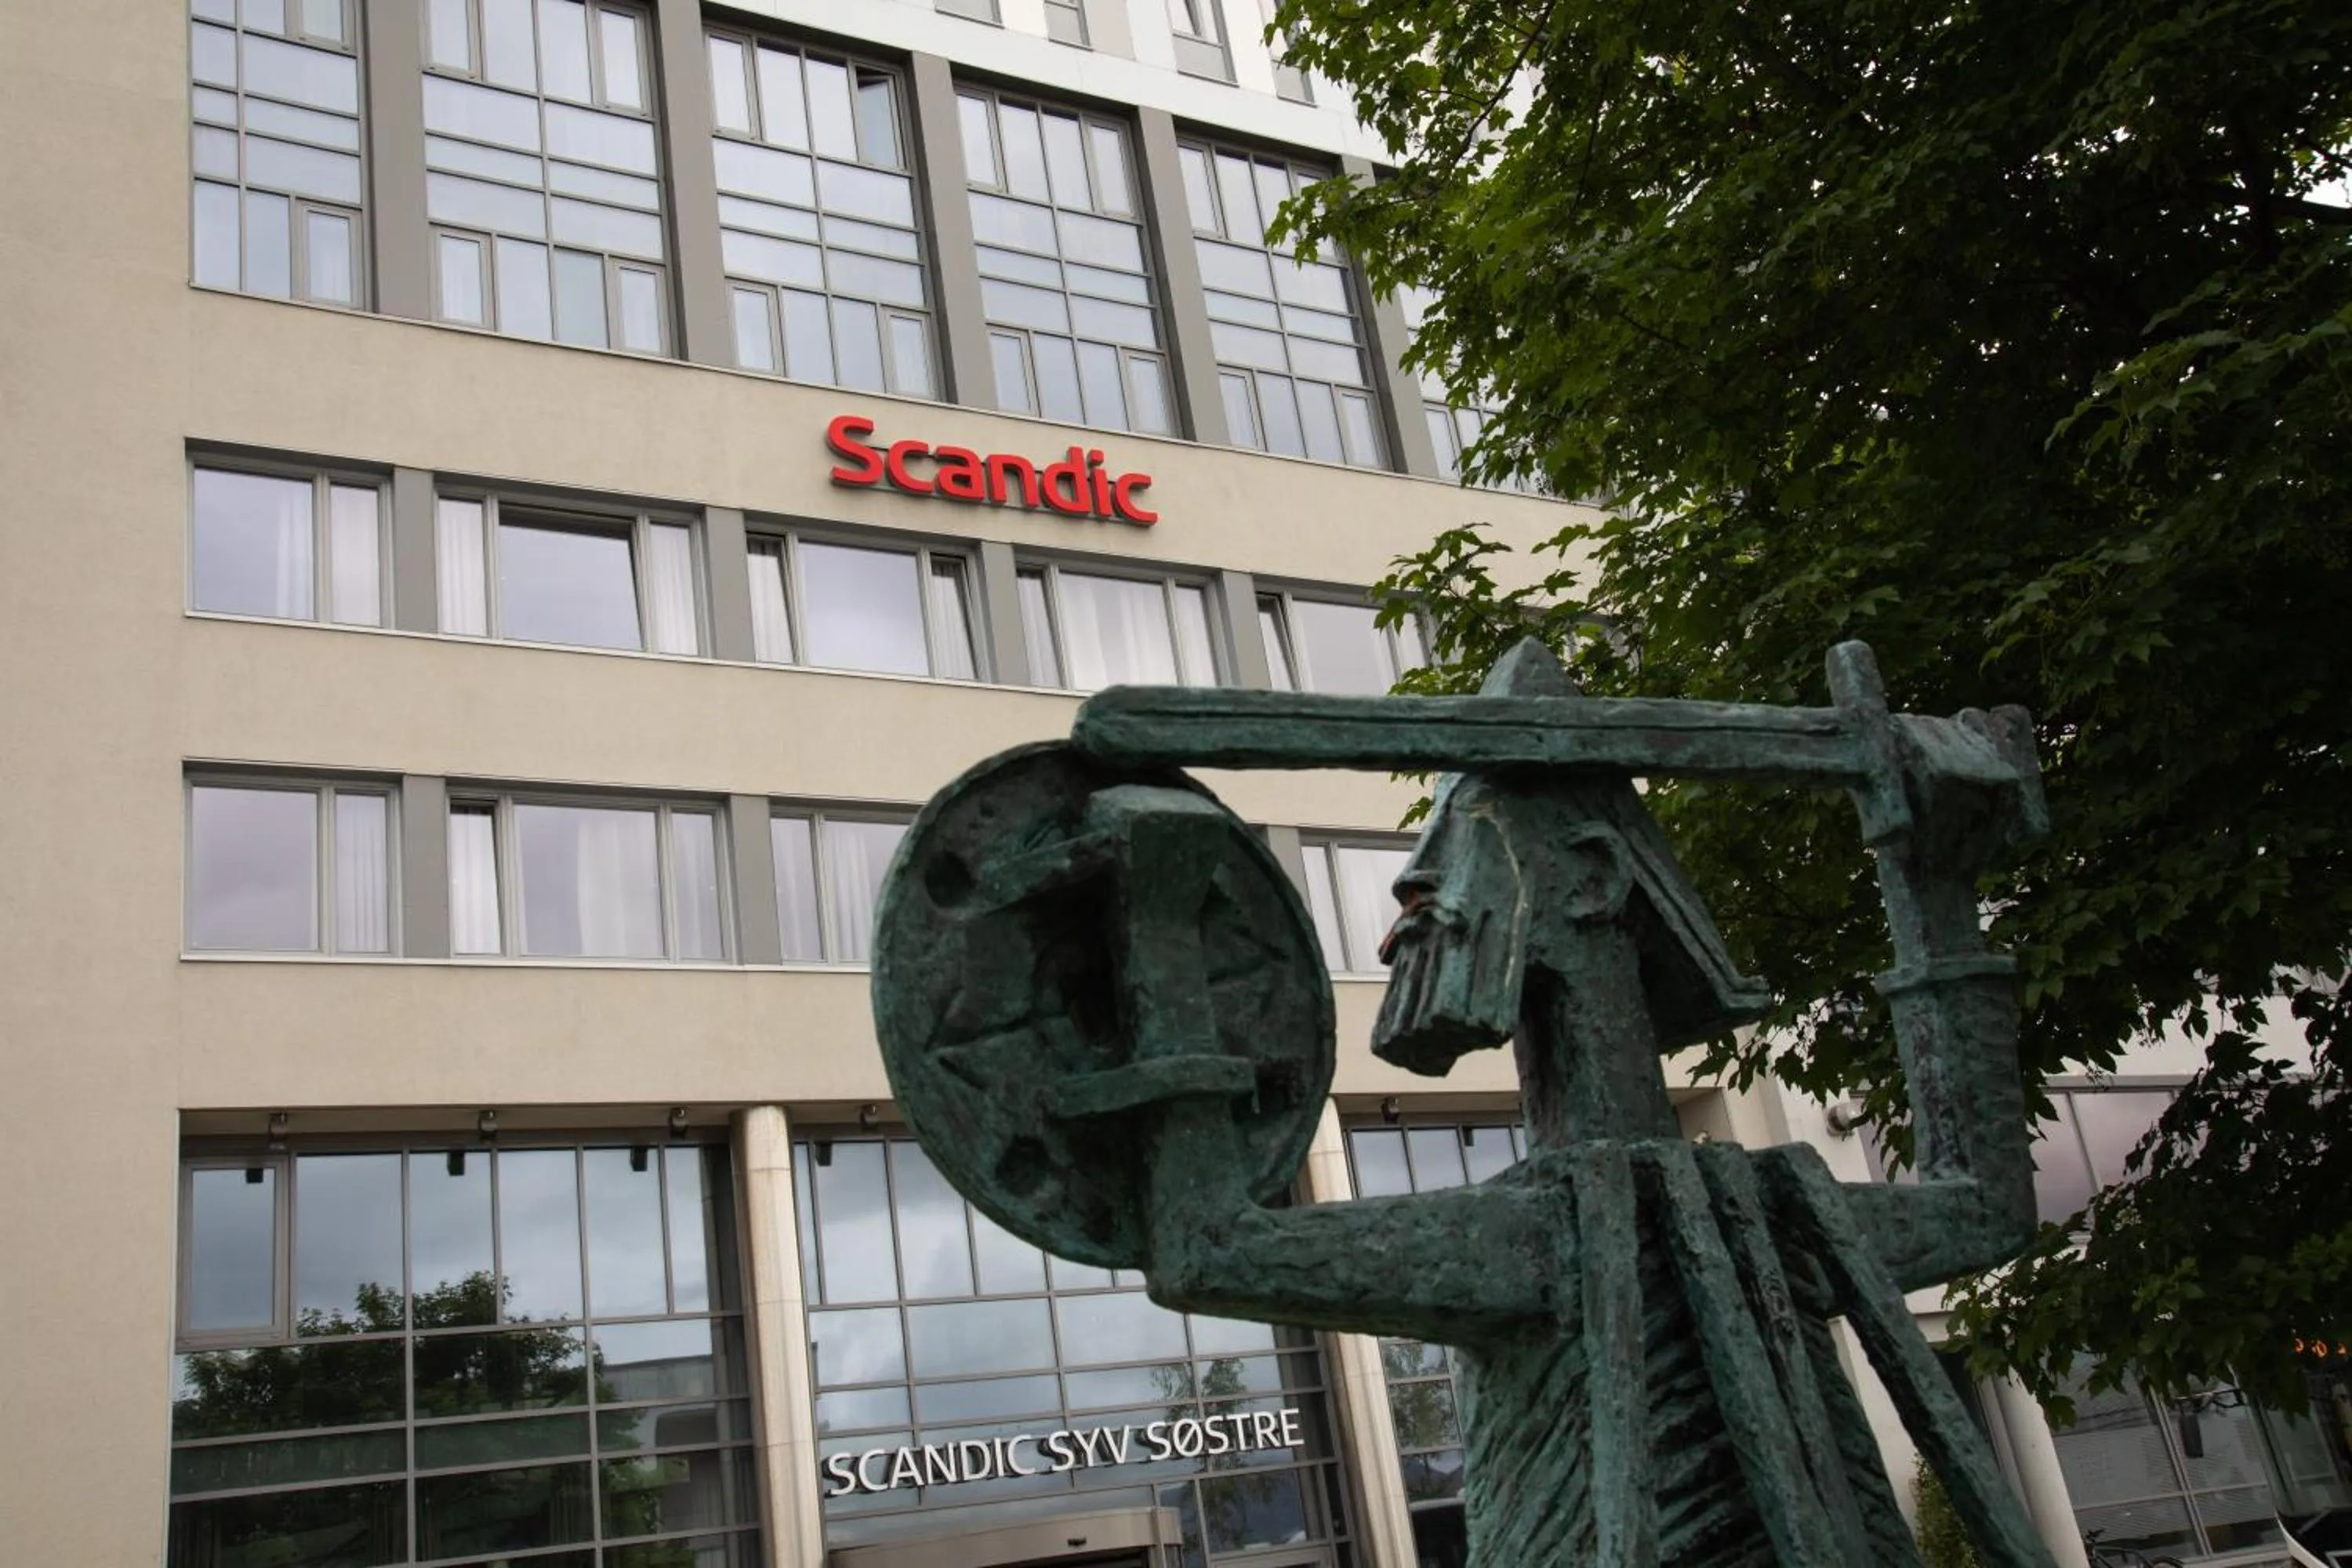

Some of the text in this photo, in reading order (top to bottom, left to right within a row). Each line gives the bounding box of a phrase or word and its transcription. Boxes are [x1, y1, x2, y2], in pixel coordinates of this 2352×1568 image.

[827, 415, 1158, 524] Scandic
[828, 1408, 1305, 1496] SCANDIC SYV SØSTRE
